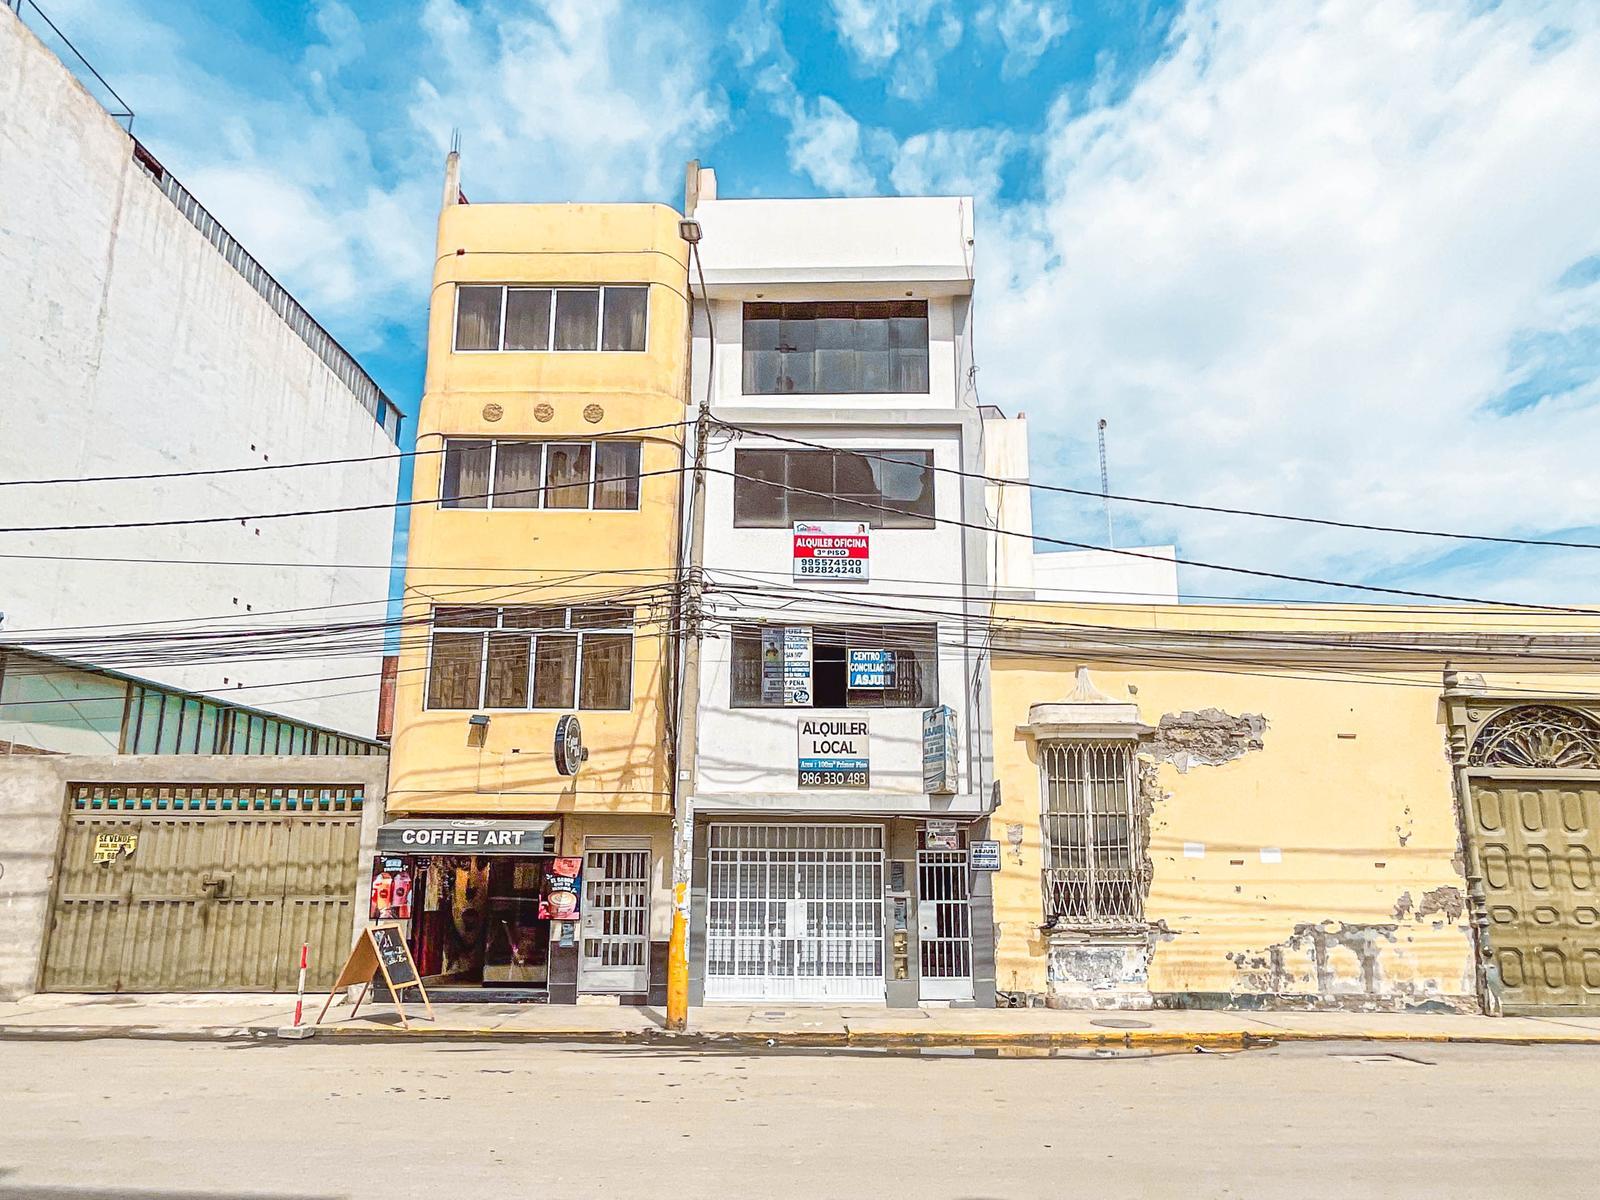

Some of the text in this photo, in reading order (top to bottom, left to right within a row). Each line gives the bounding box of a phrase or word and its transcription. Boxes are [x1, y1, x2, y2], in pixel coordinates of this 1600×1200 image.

[796, 538, 867, 548] ALQUILER OFICINA
[801, 566, 862, 574] 982824248
[853, 651, 880, 661] CENTRO
[802, 721, 867, 737] ALQUILER
[813, 740, 857, 754] LOCAL
[801, 772, 866, 785] 986 330 483
[109, 835, 131, 843] VENDE
[402, 830, 525, 845] COFFEE ART
